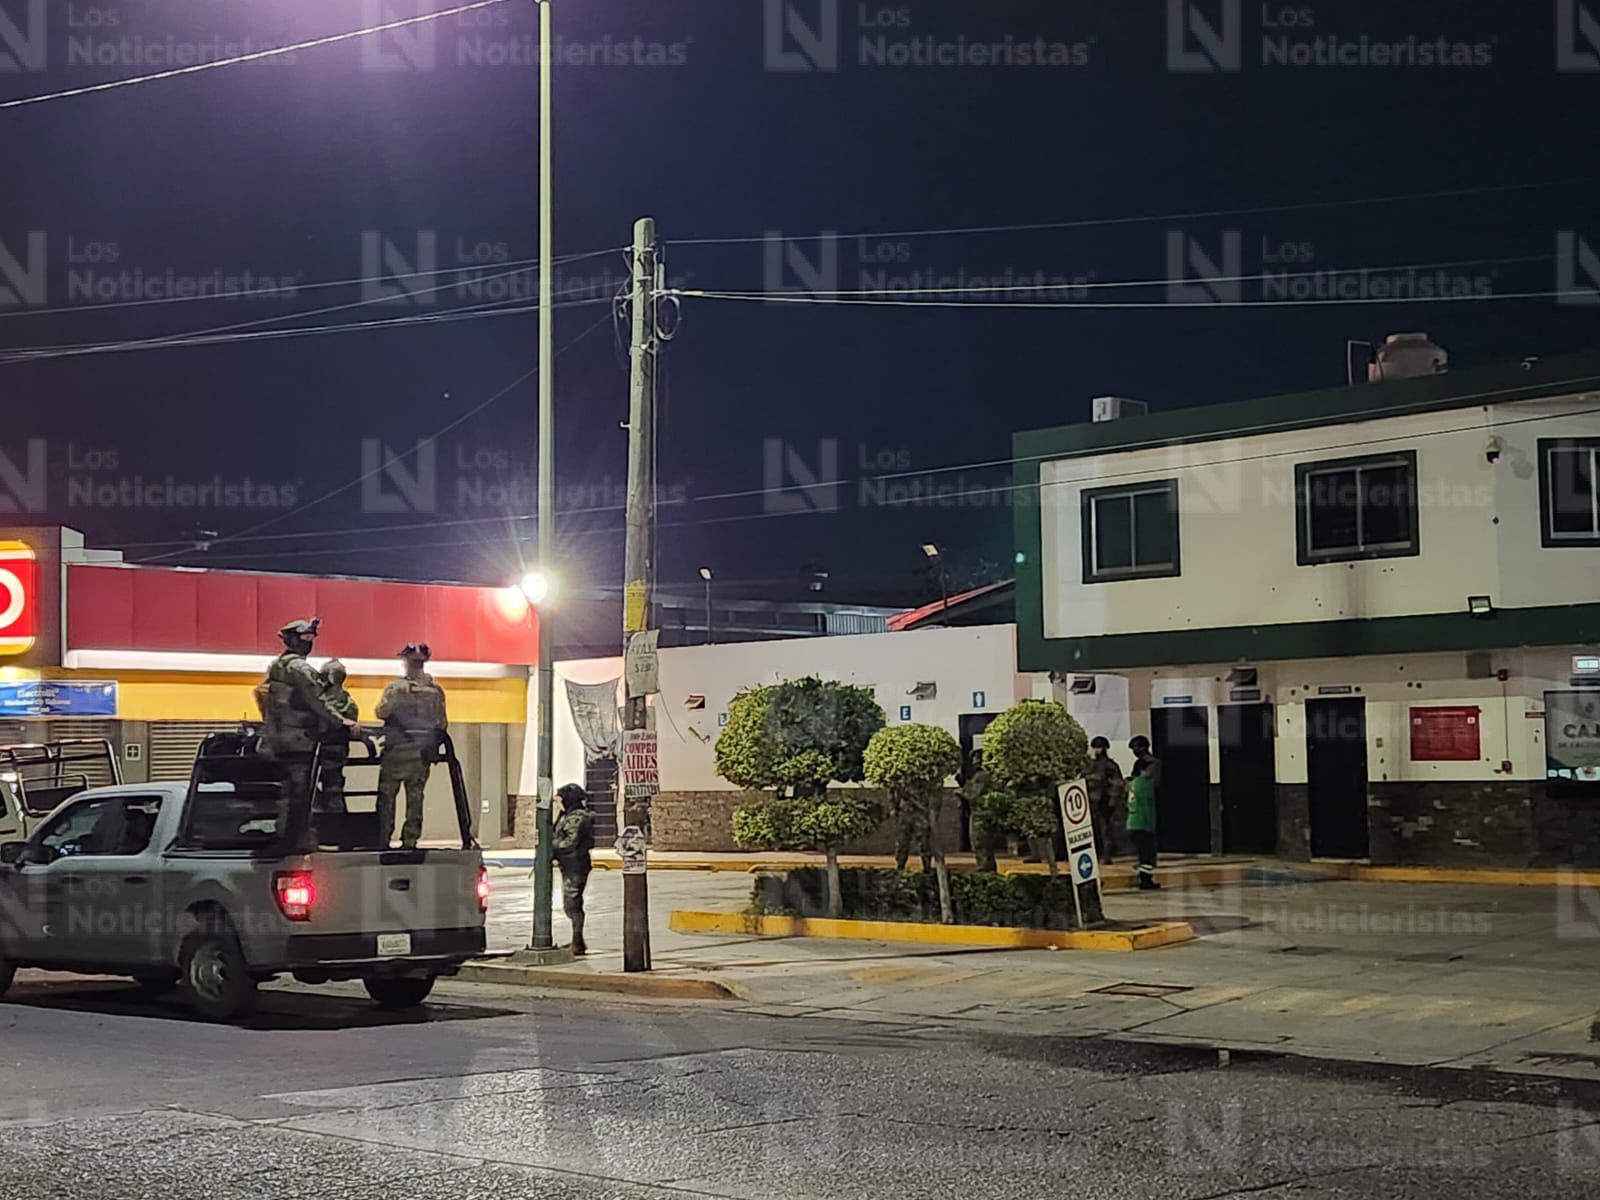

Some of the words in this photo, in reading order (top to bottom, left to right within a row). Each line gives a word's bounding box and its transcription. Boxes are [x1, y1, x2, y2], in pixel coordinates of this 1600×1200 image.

[624, 743, 657, 754] COMPRO
[624, 755, 657, 769] AIRES
[624, 770, 659, 784] VIEJOS
[1068, 792, 1082, 812] 10
